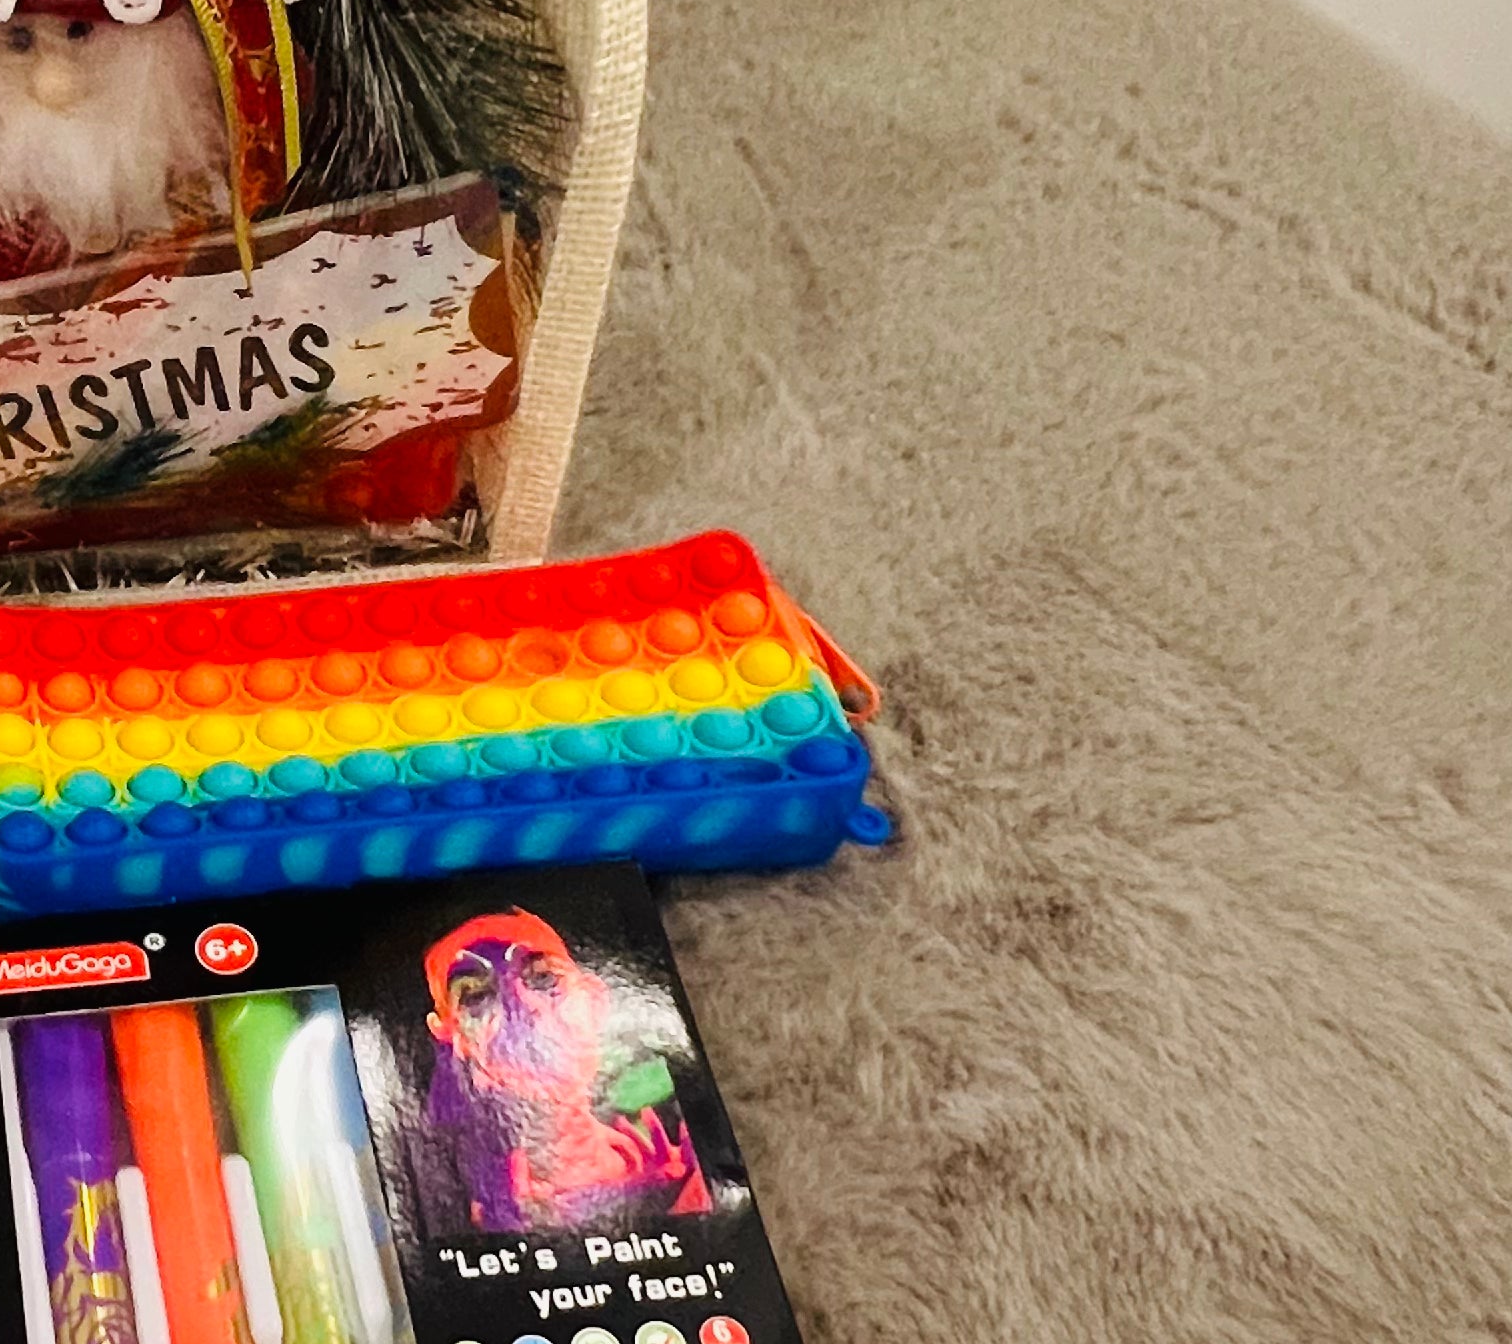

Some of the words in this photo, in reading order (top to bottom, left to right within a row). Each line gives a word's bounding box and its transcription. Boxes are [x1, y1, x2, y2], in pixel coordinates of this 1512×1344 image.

[204, 938, 248, 961] 6+
[584, 1232, 683, 1264] Paint
[528, 1280, 613, 1320] your
